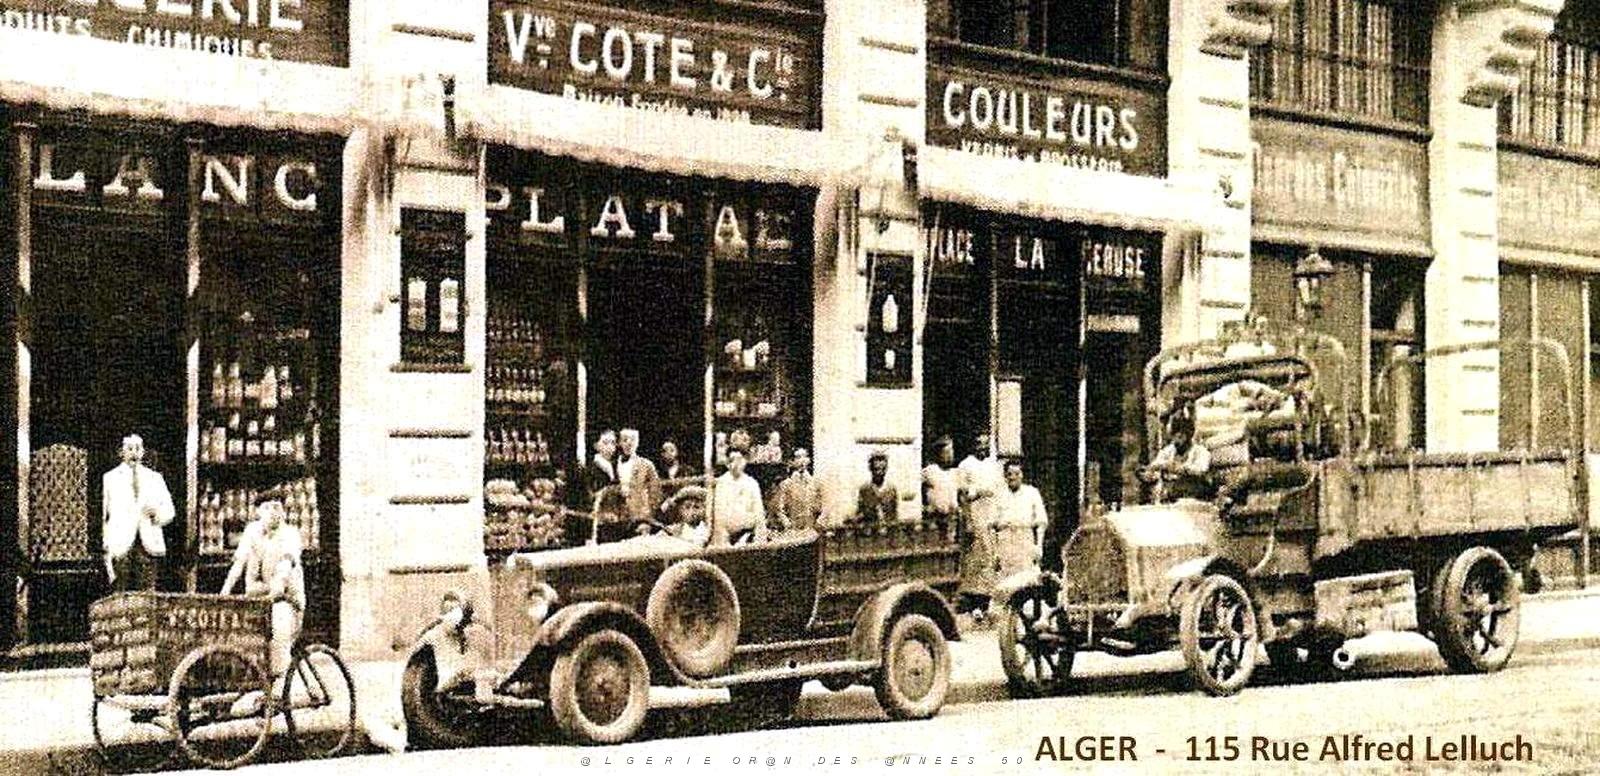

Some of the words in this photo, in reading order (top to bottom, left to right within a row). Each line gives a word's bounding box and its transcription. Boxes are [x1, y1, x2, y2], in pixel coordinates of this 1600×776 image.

[570, 23, 697, 88] COTE
[711, 51, 736, 93] &
[944, 80, 1139, 150] COULEURS
[1014, 236, 1045, 270] LA
